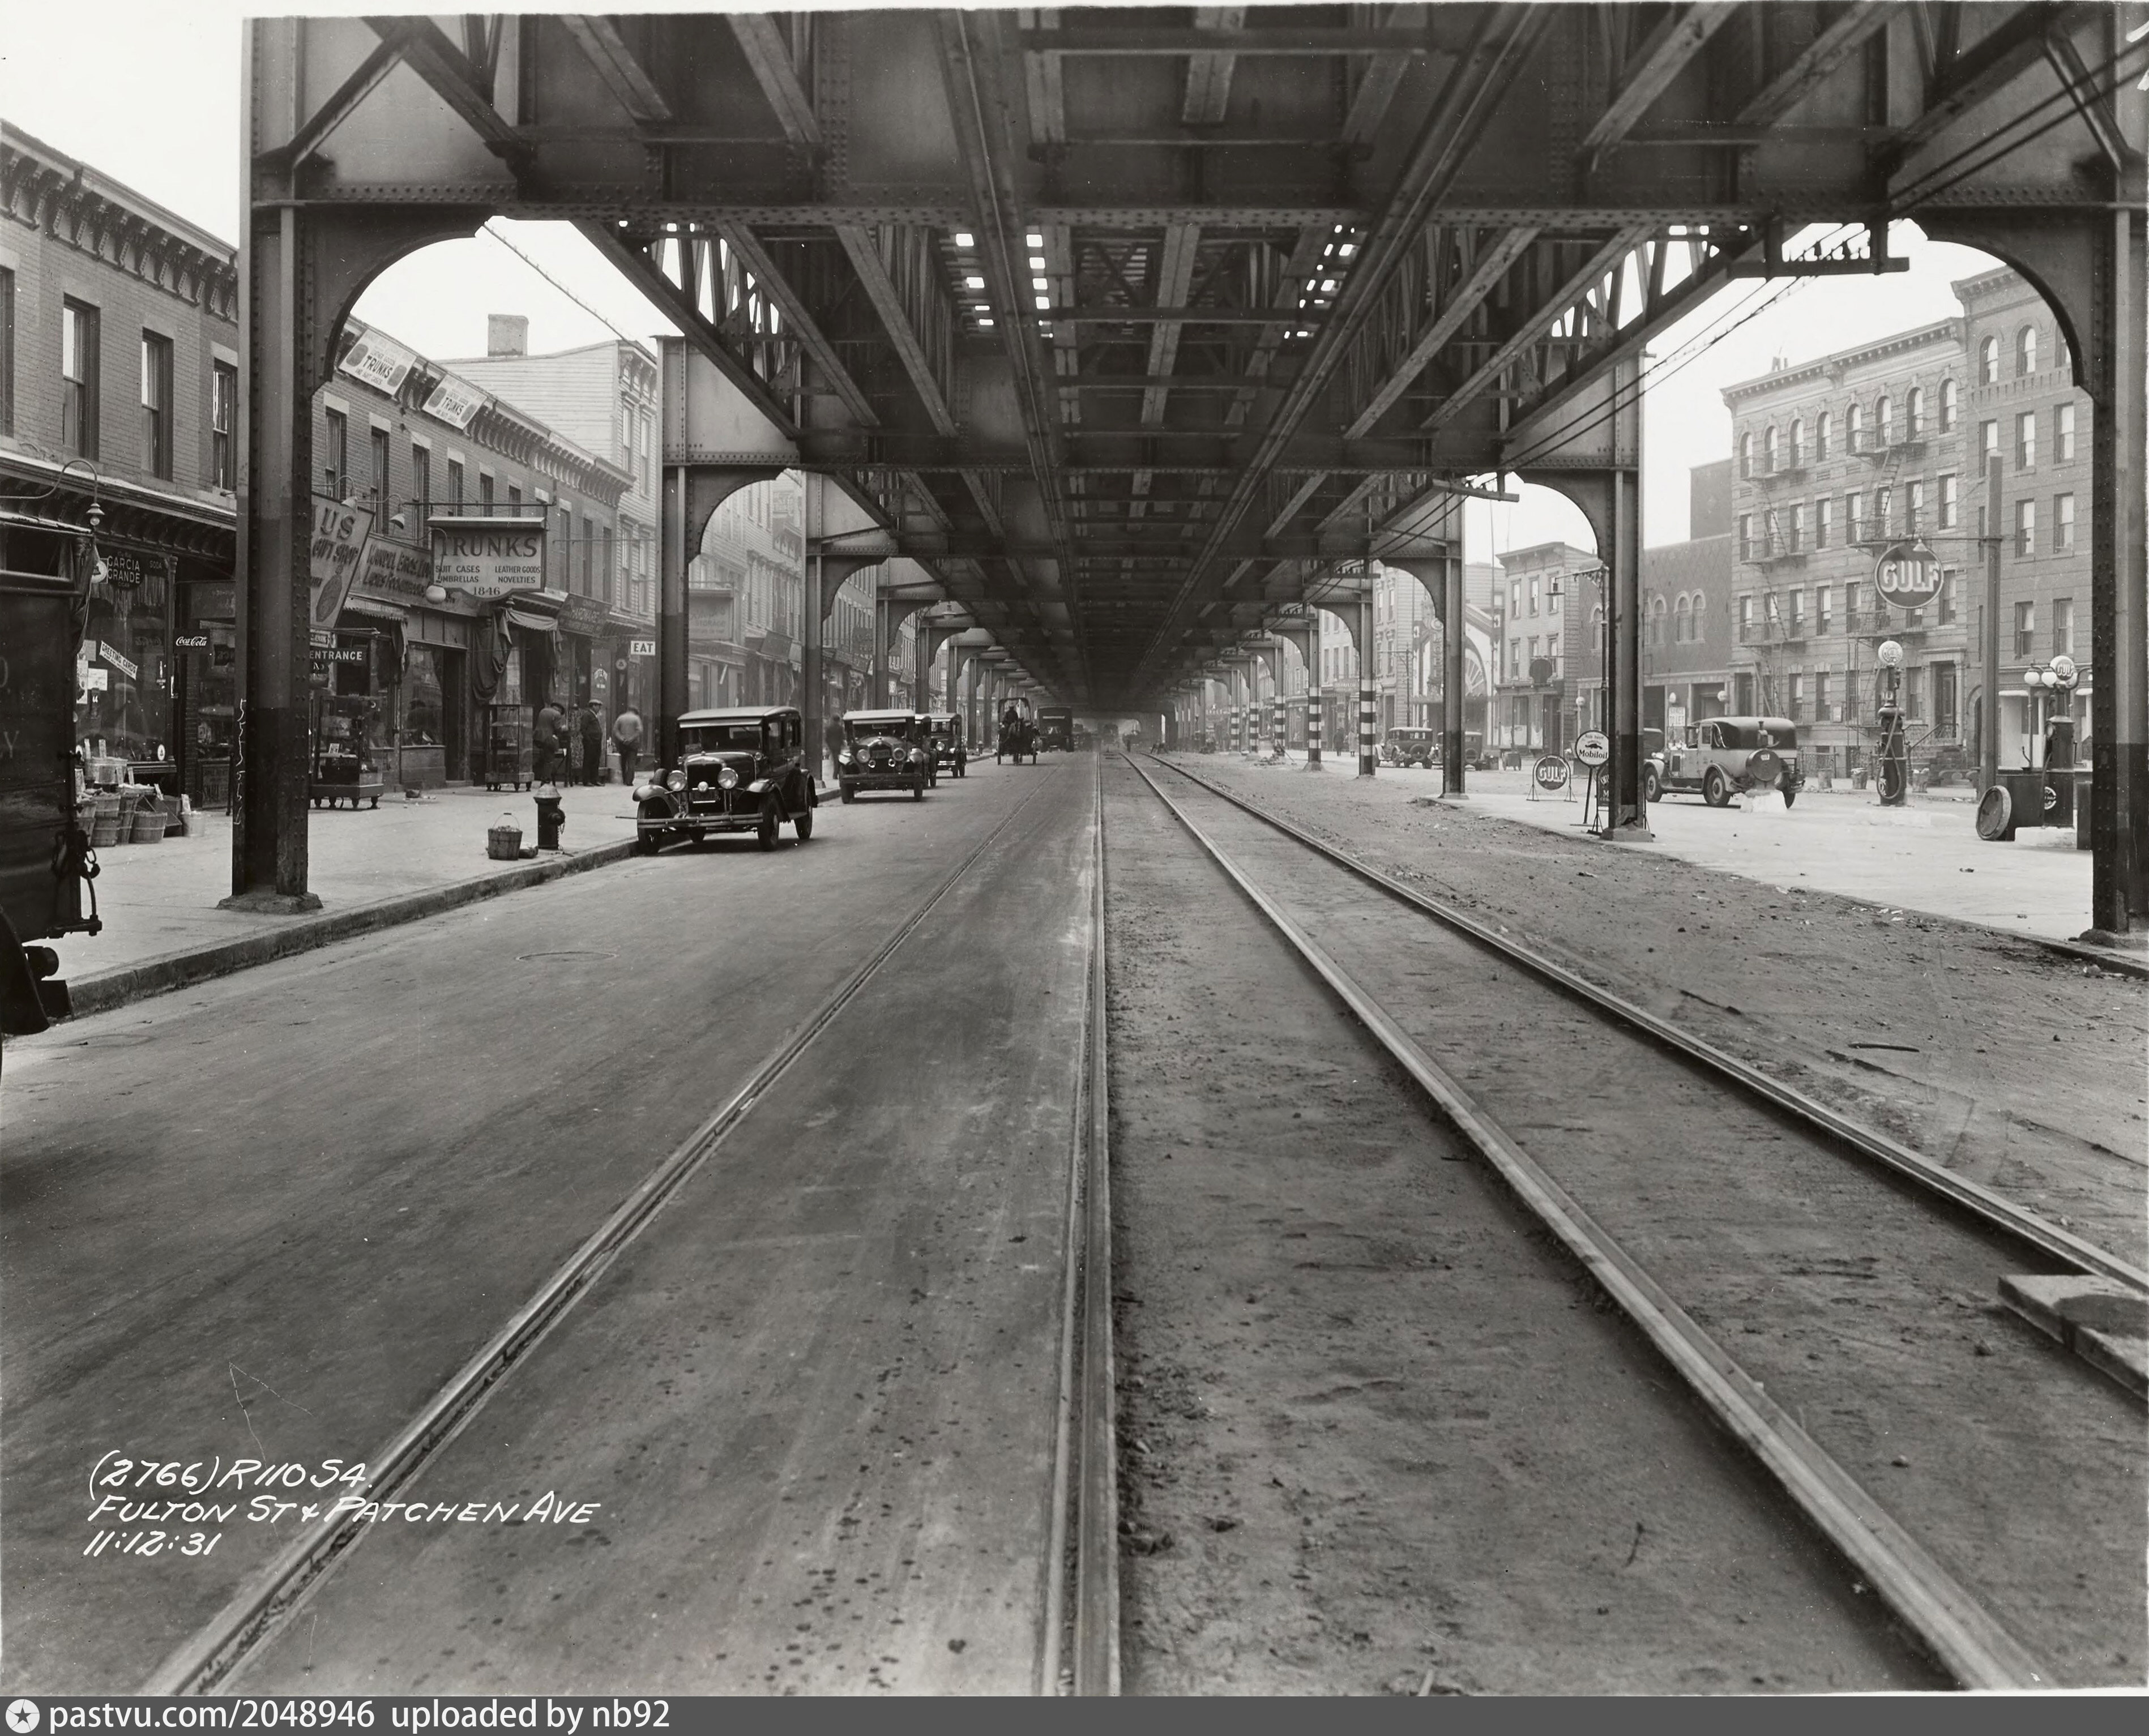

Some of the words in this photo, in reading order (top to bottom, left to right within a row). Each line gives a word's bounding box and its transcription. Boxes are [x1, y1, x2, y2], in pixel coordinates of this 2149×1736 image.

[363, 355, 393, 378] TRUNKS
[441, 396, 465, 416] TRUNKS
[438, 537, 538, 557] TRUNKS
[108, 555, 140, 572] GARCIA
[456, 565, 480, 574] CASES
[522, 566, 541, 574] GOODS
[108, 568, 140, 584] GRANDE
[1879, 559, 1939, 593] GULF
[473, 587, 501, 596] 1846
[309, 649, 363, 661] ENTRANCE
[633, 643, 653, 653] EAT
[1579, 749, 1608, 759] Mobiloil
[1538, 766, 1567, 783] GULF
